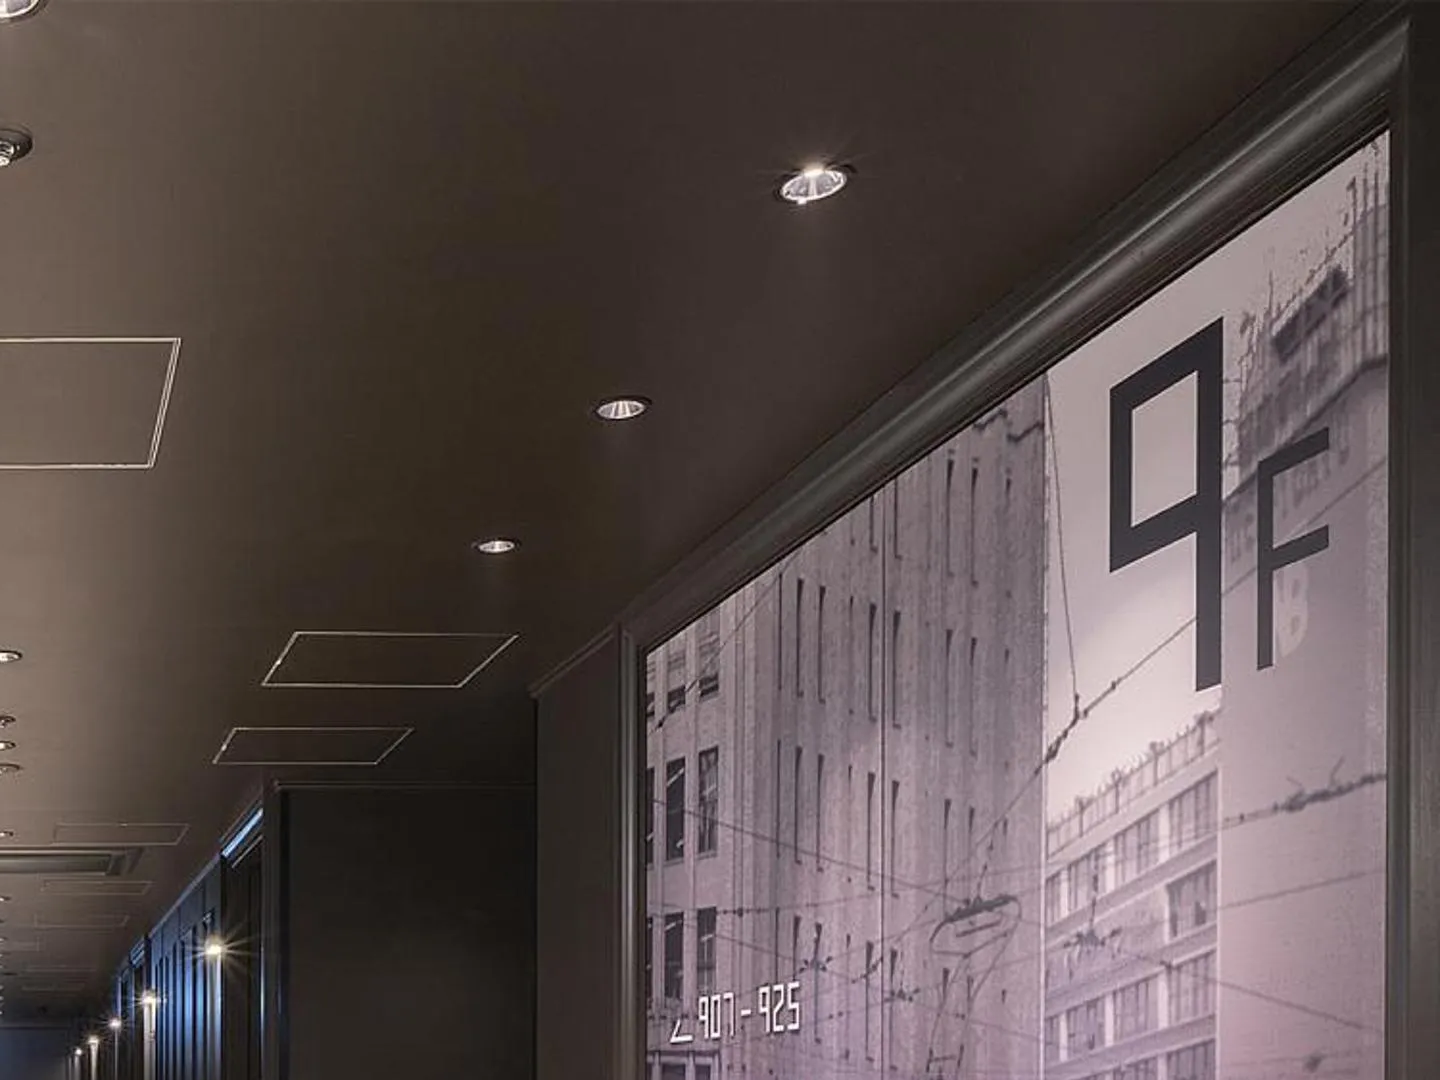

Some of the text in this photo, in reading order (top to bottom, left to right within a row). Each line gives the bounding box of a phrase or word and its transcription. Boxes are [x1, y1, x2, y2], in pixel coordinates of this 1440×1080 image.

[1108, 316, 1330, 692] 9F
[698, 992, 735, 1039] 907
[759, 981, 801, 1033] 925
